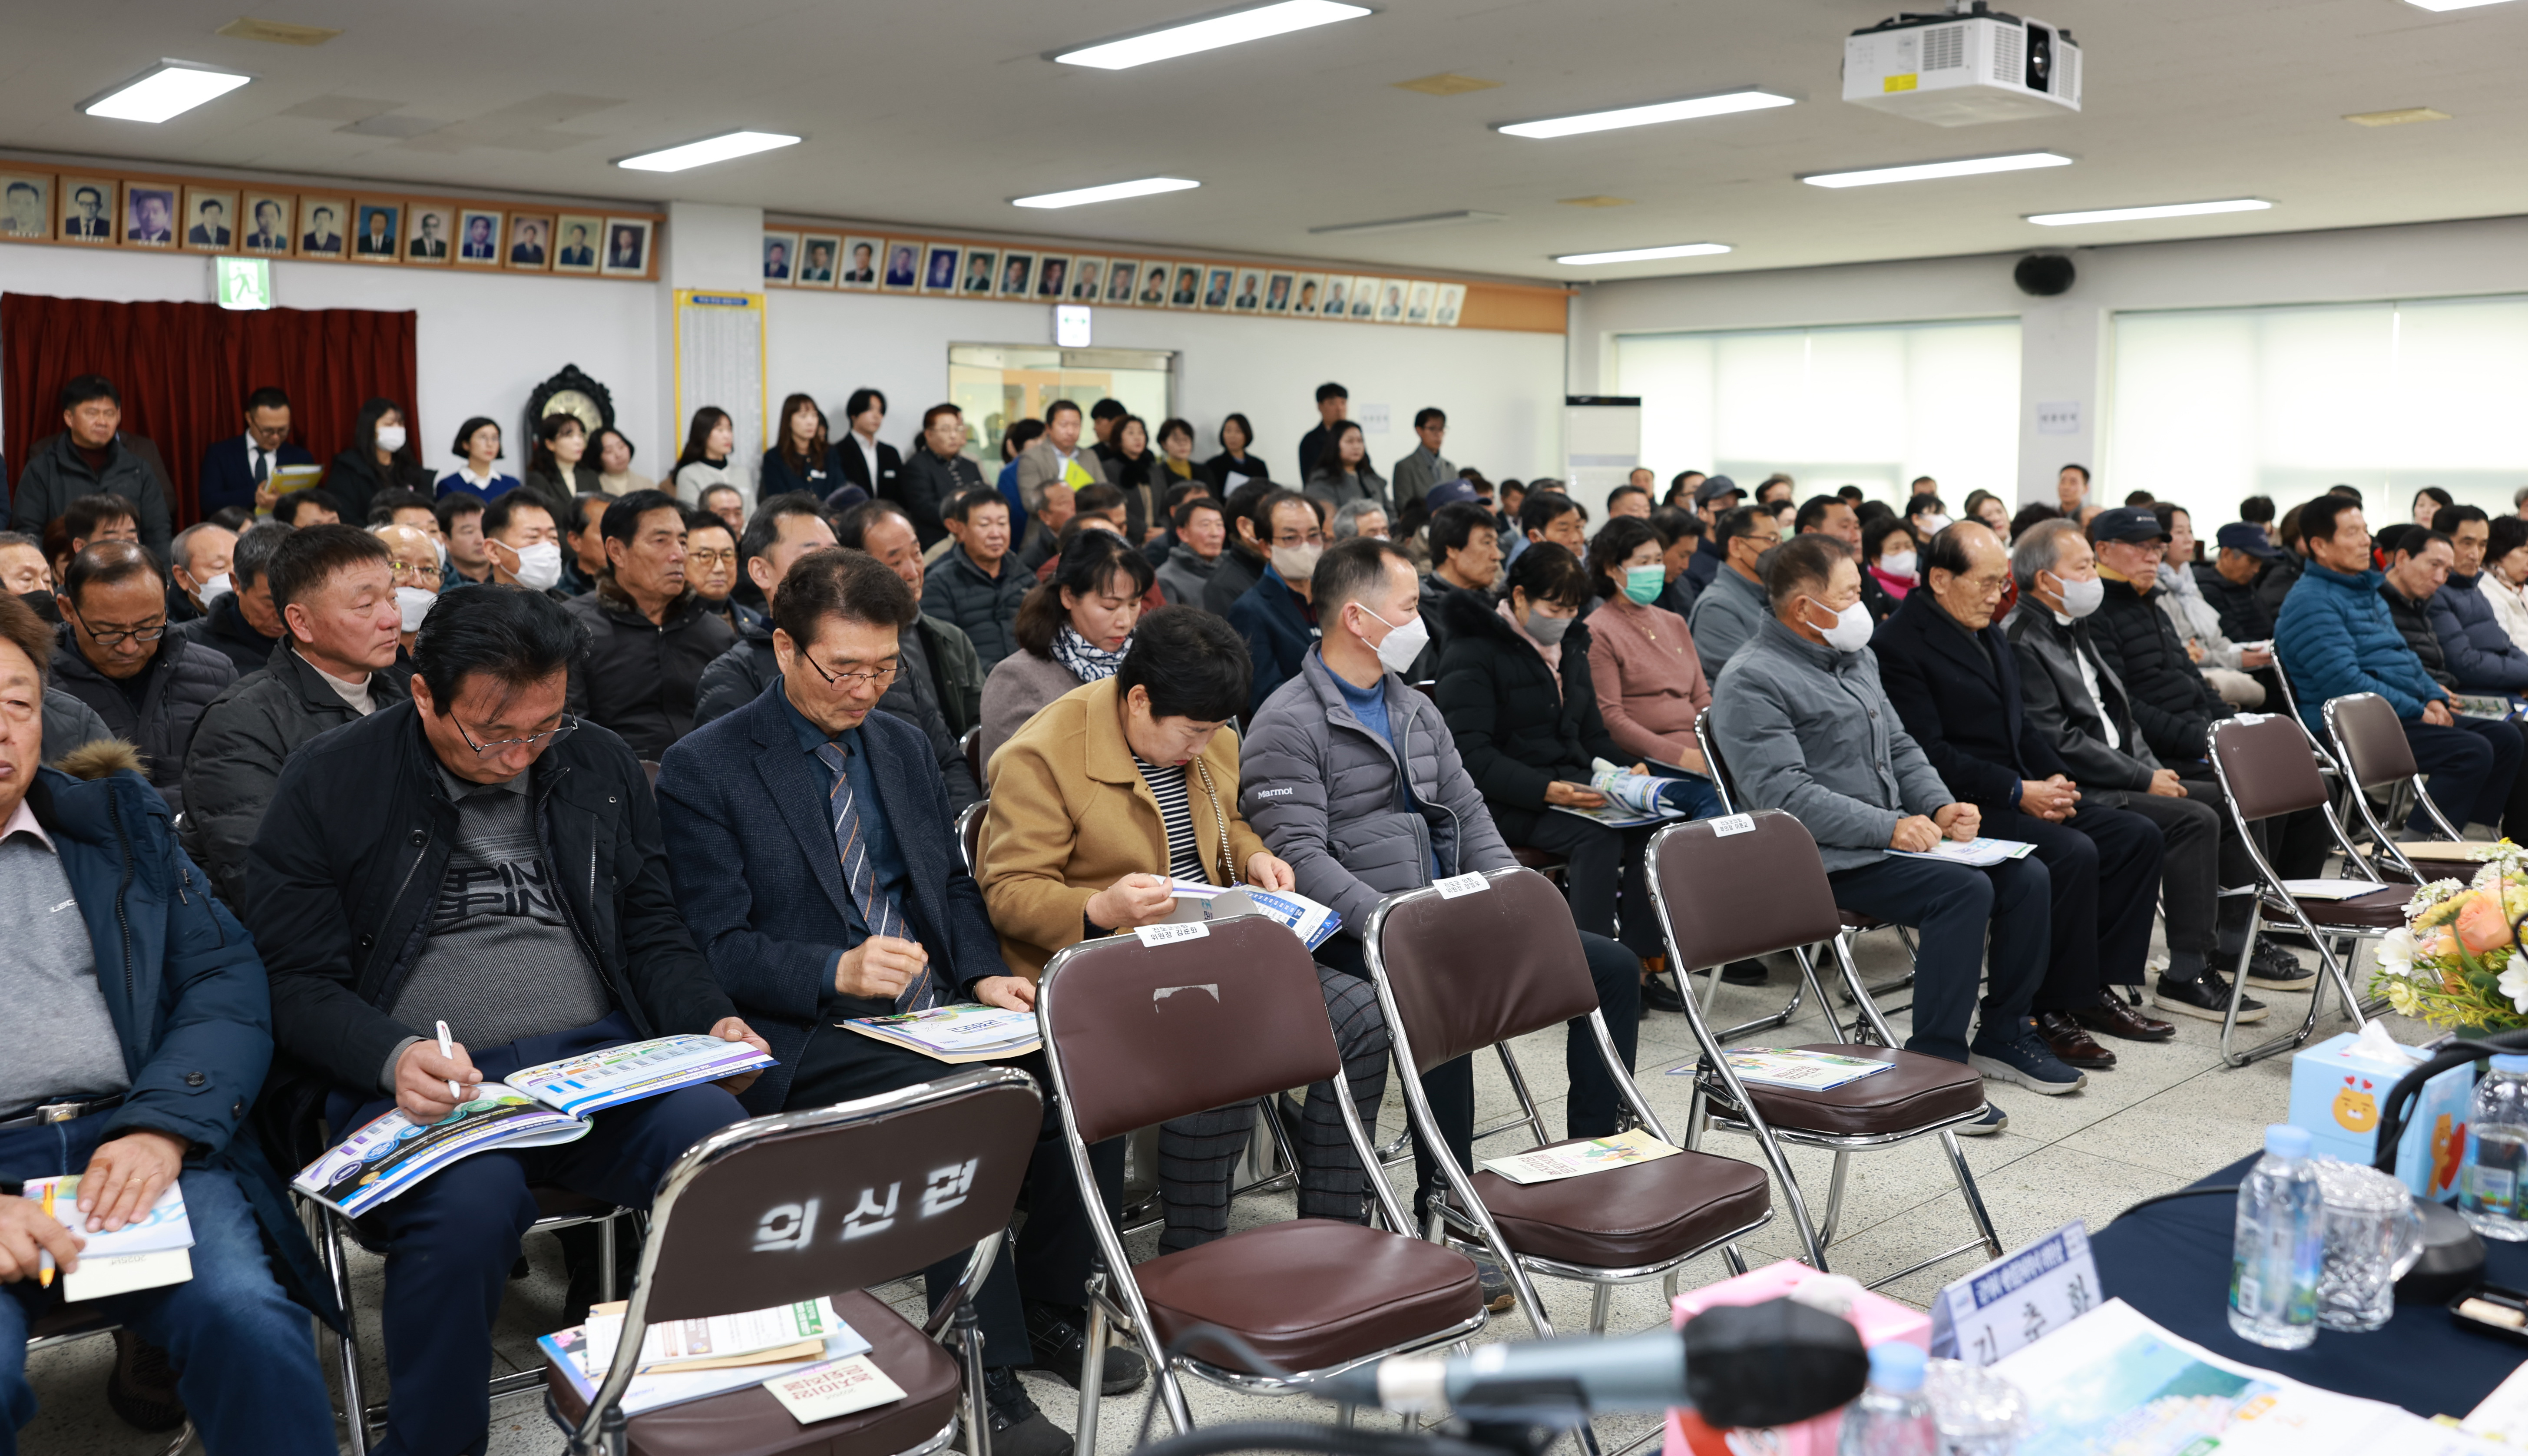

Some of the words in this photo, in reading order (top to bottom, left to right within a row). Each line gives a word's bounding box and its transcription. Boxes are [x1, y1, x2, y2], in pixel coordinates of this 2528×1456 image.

[1257, 787, 1293, 799] Marmot
[1151, 932, 1172, 940] 위원장
[1303, 924, 1316, 937] 의신면
[946, 1019, 1002, 1032] 군정보고
[752, 1158, 979, 1251] 의신면
[784, 1364, 864, 1392] 은퇴직불
[792, 1371, 874, 1401] 농지이양
